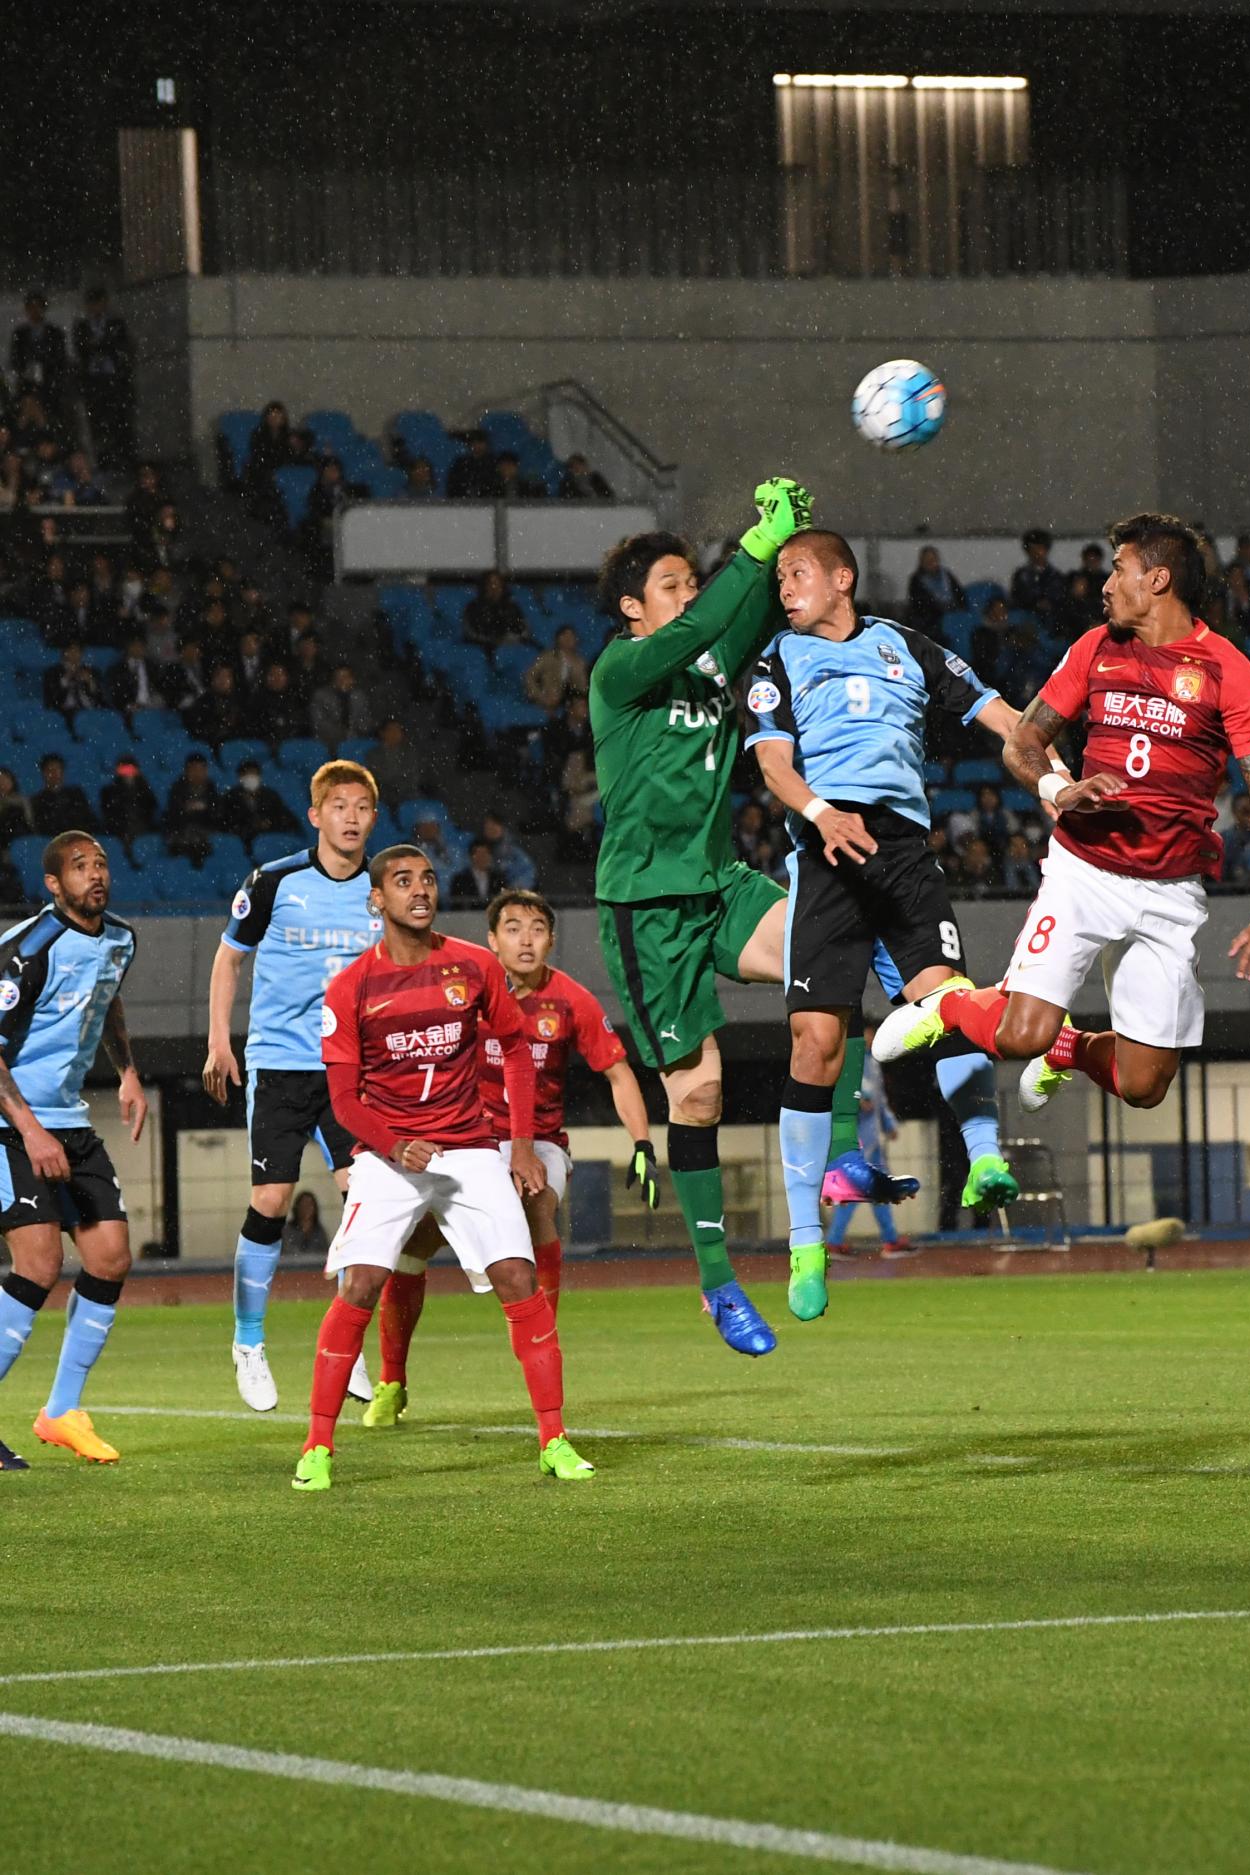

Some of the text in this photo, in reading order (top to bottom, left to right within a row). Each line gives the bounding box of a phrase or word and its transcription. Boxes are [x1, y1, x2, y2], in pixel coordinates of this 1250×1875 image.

[845, 675, 870, 715] 9
[1102, 713, 1183, 739] HDFAX.COM
[1125, 733, 1152, 779] 8
[938, 920, 962, 961] 9
[1028, 915, 1057, 954] 8
[385, 1021, 463, 1053] 恒大金服
[417, 1063, 436, 1102] 7
